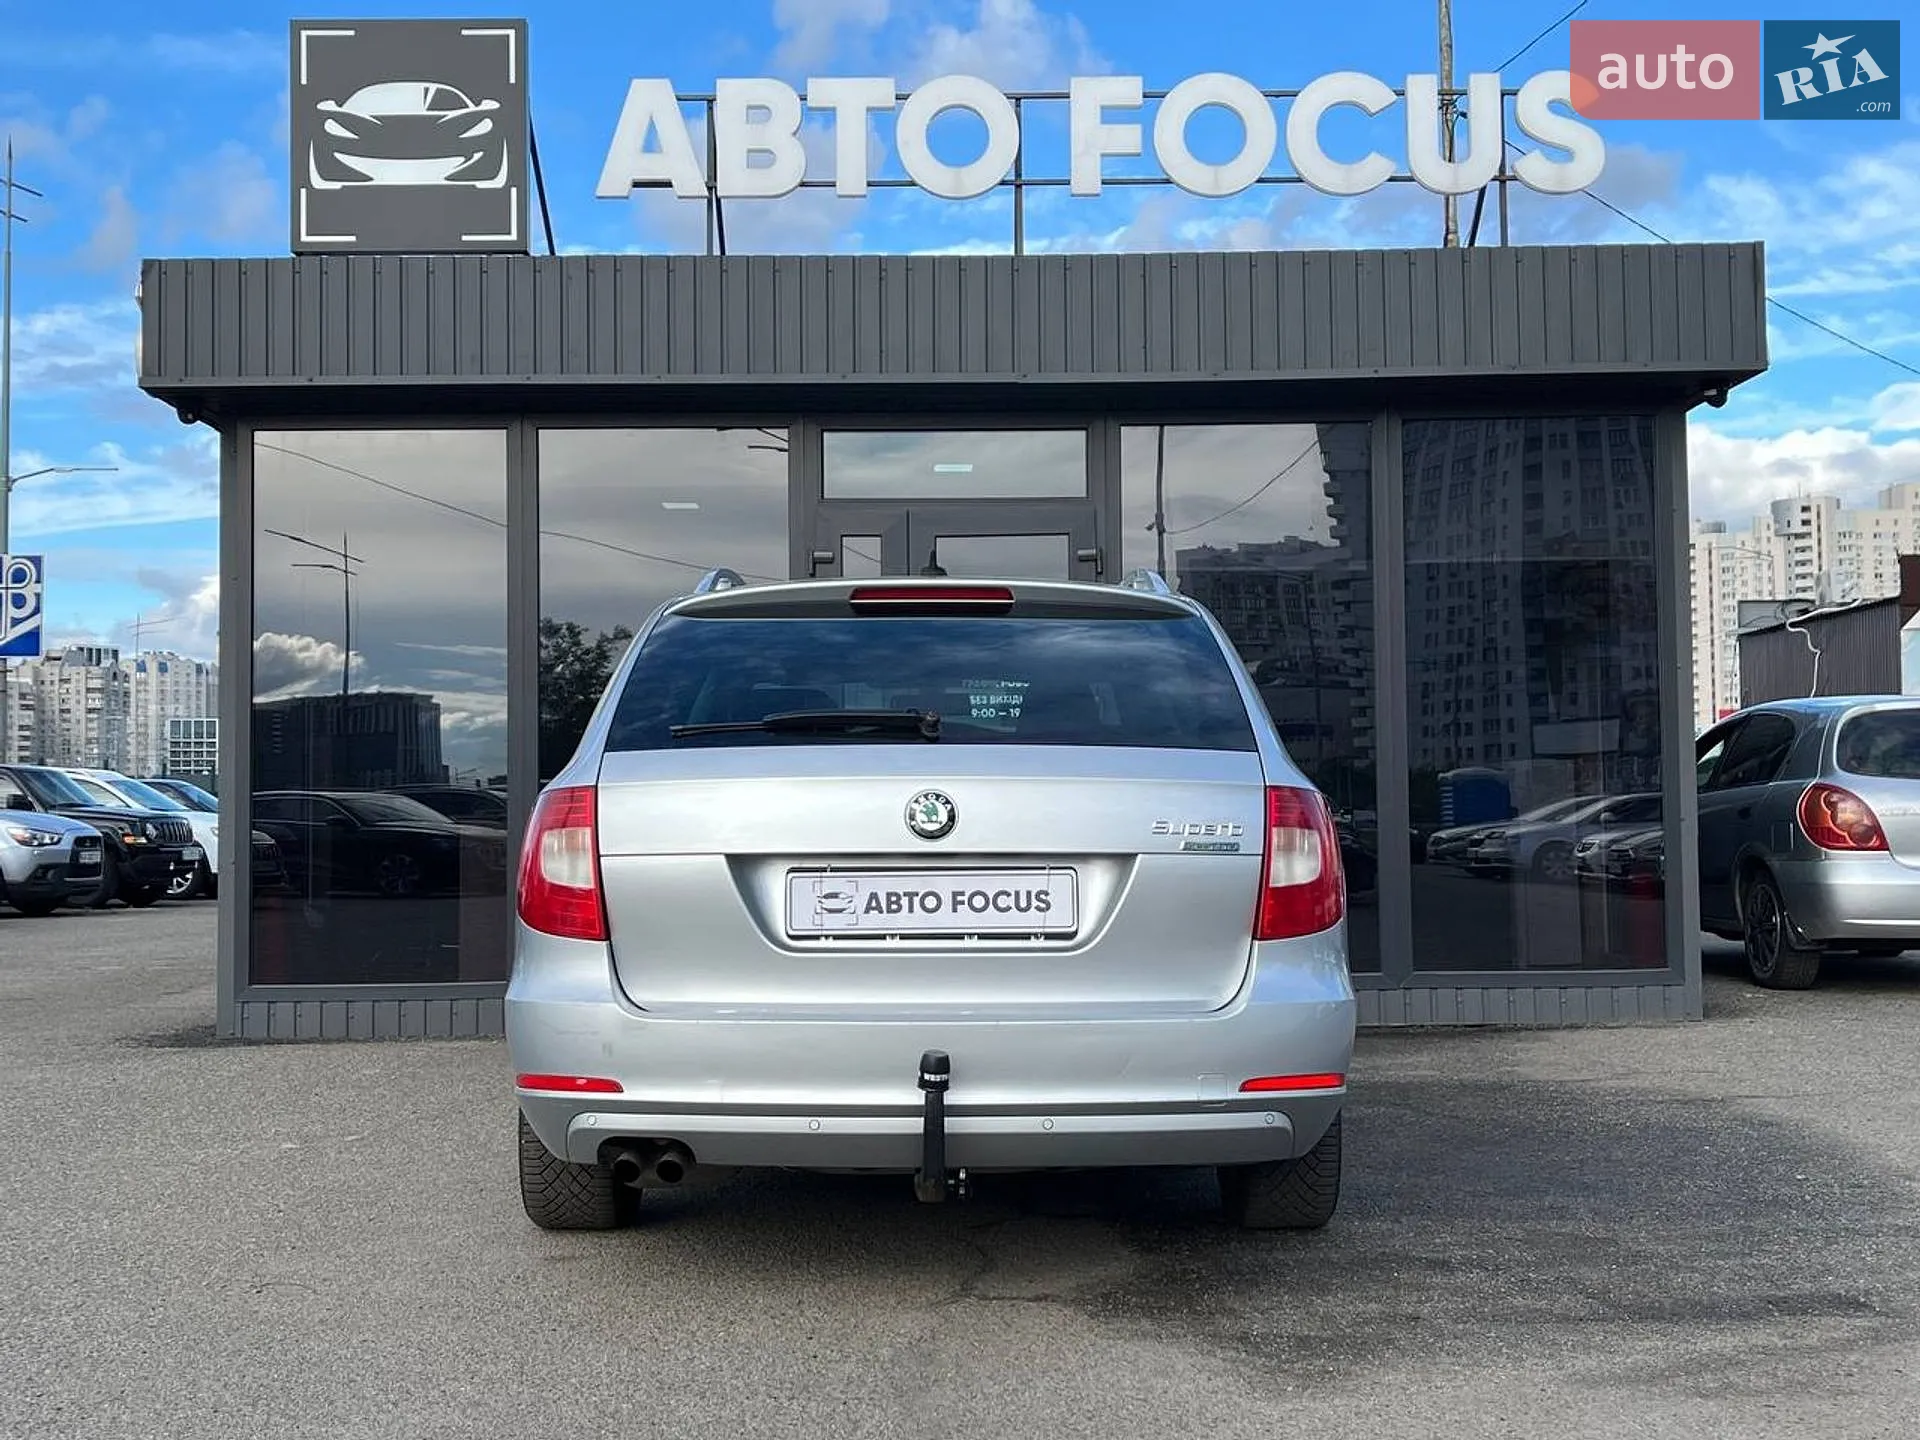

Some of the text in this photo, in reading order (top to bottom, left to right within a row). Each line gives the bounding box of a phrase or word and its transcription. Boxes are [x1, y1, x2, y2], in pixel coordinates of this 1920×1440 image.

[595, 69, 1607, 200] АВТО FOCUS
[971, 707, 996, 718] 9:00
[1151, 820, 1244, 837] Superb
[863, 889, 1051, 915] АВТО FOCUS
